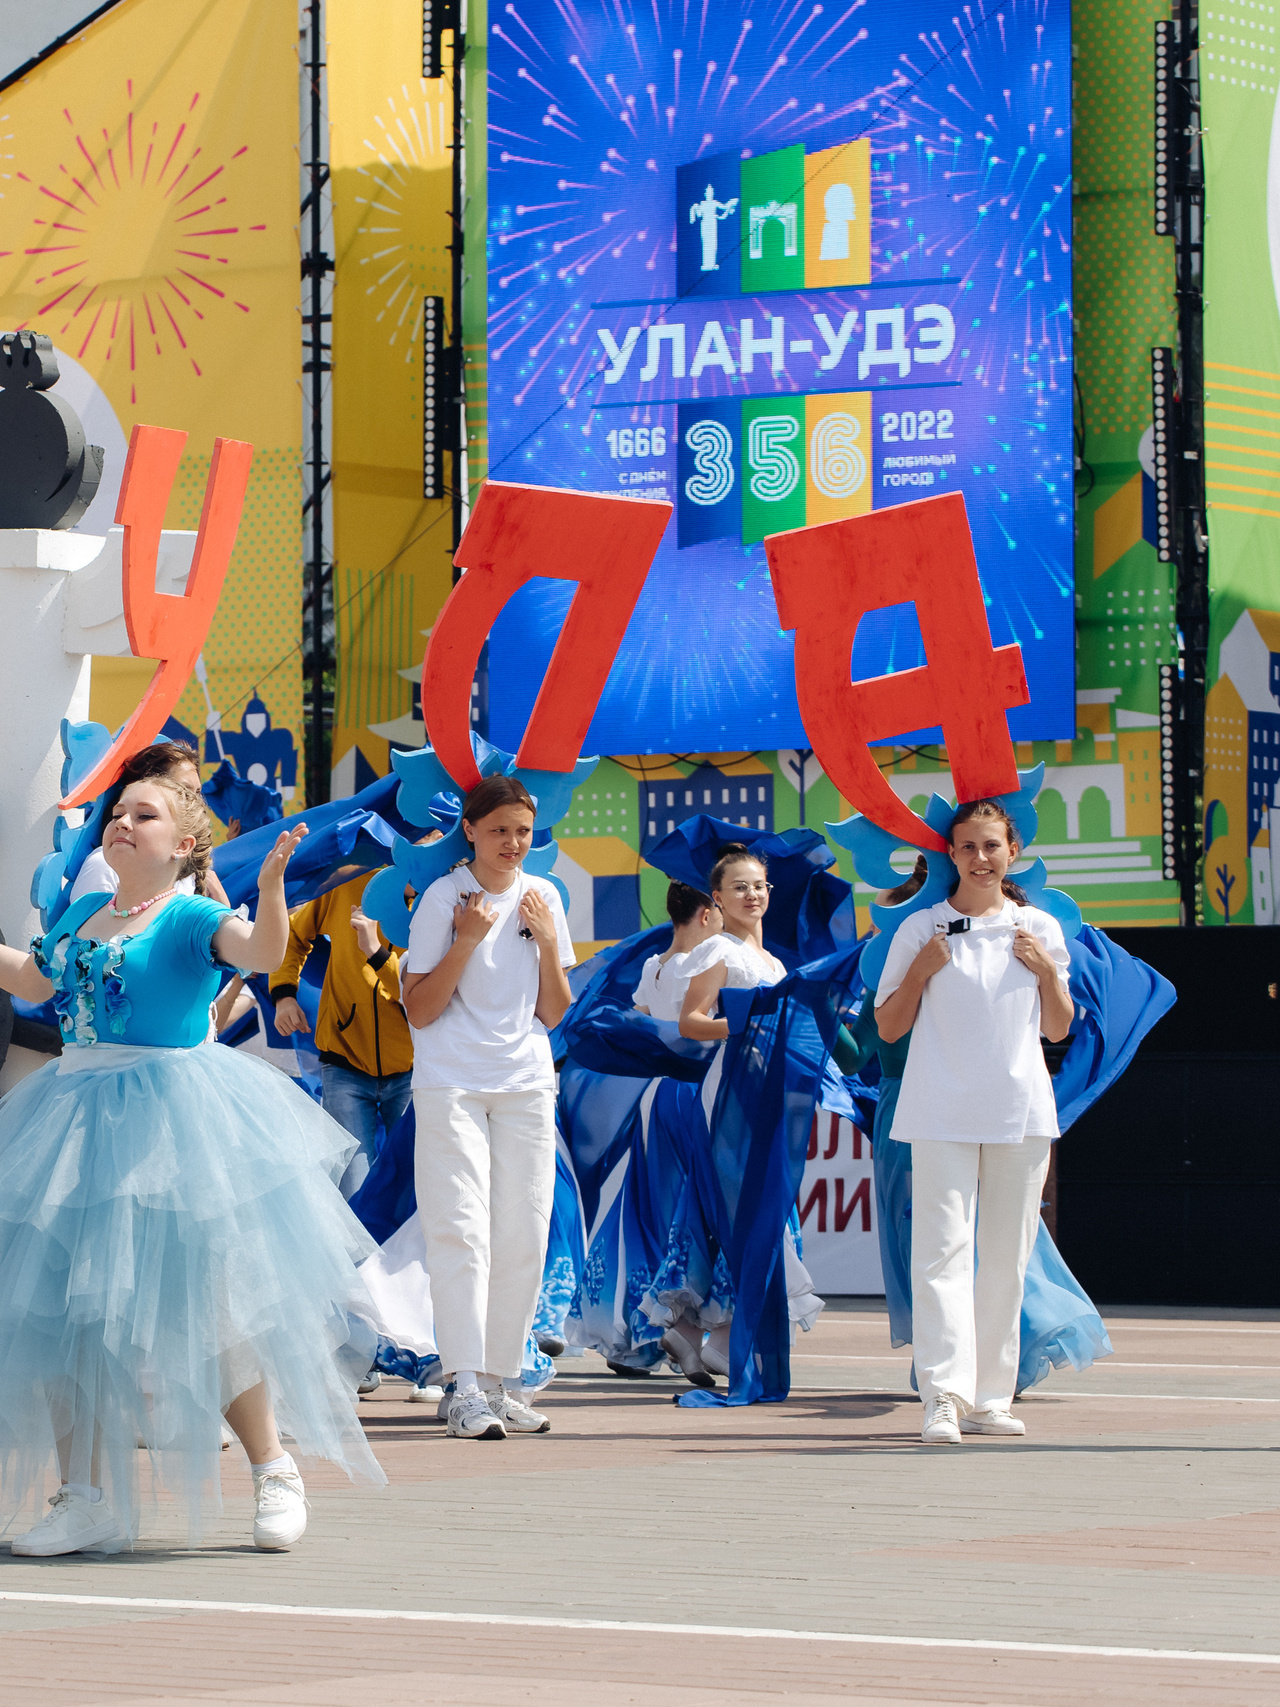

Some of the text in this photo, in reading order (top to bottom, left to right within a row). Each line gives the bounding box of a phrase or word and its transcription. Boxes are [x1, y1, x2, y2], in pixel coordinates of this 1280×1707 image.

[597, 303, 956, 385] УЛАН-УДЭ
[605, 426, 667, 459] 1666
[881, 409, 955, 443] 2022
[685, 411, 867, 506] 356
